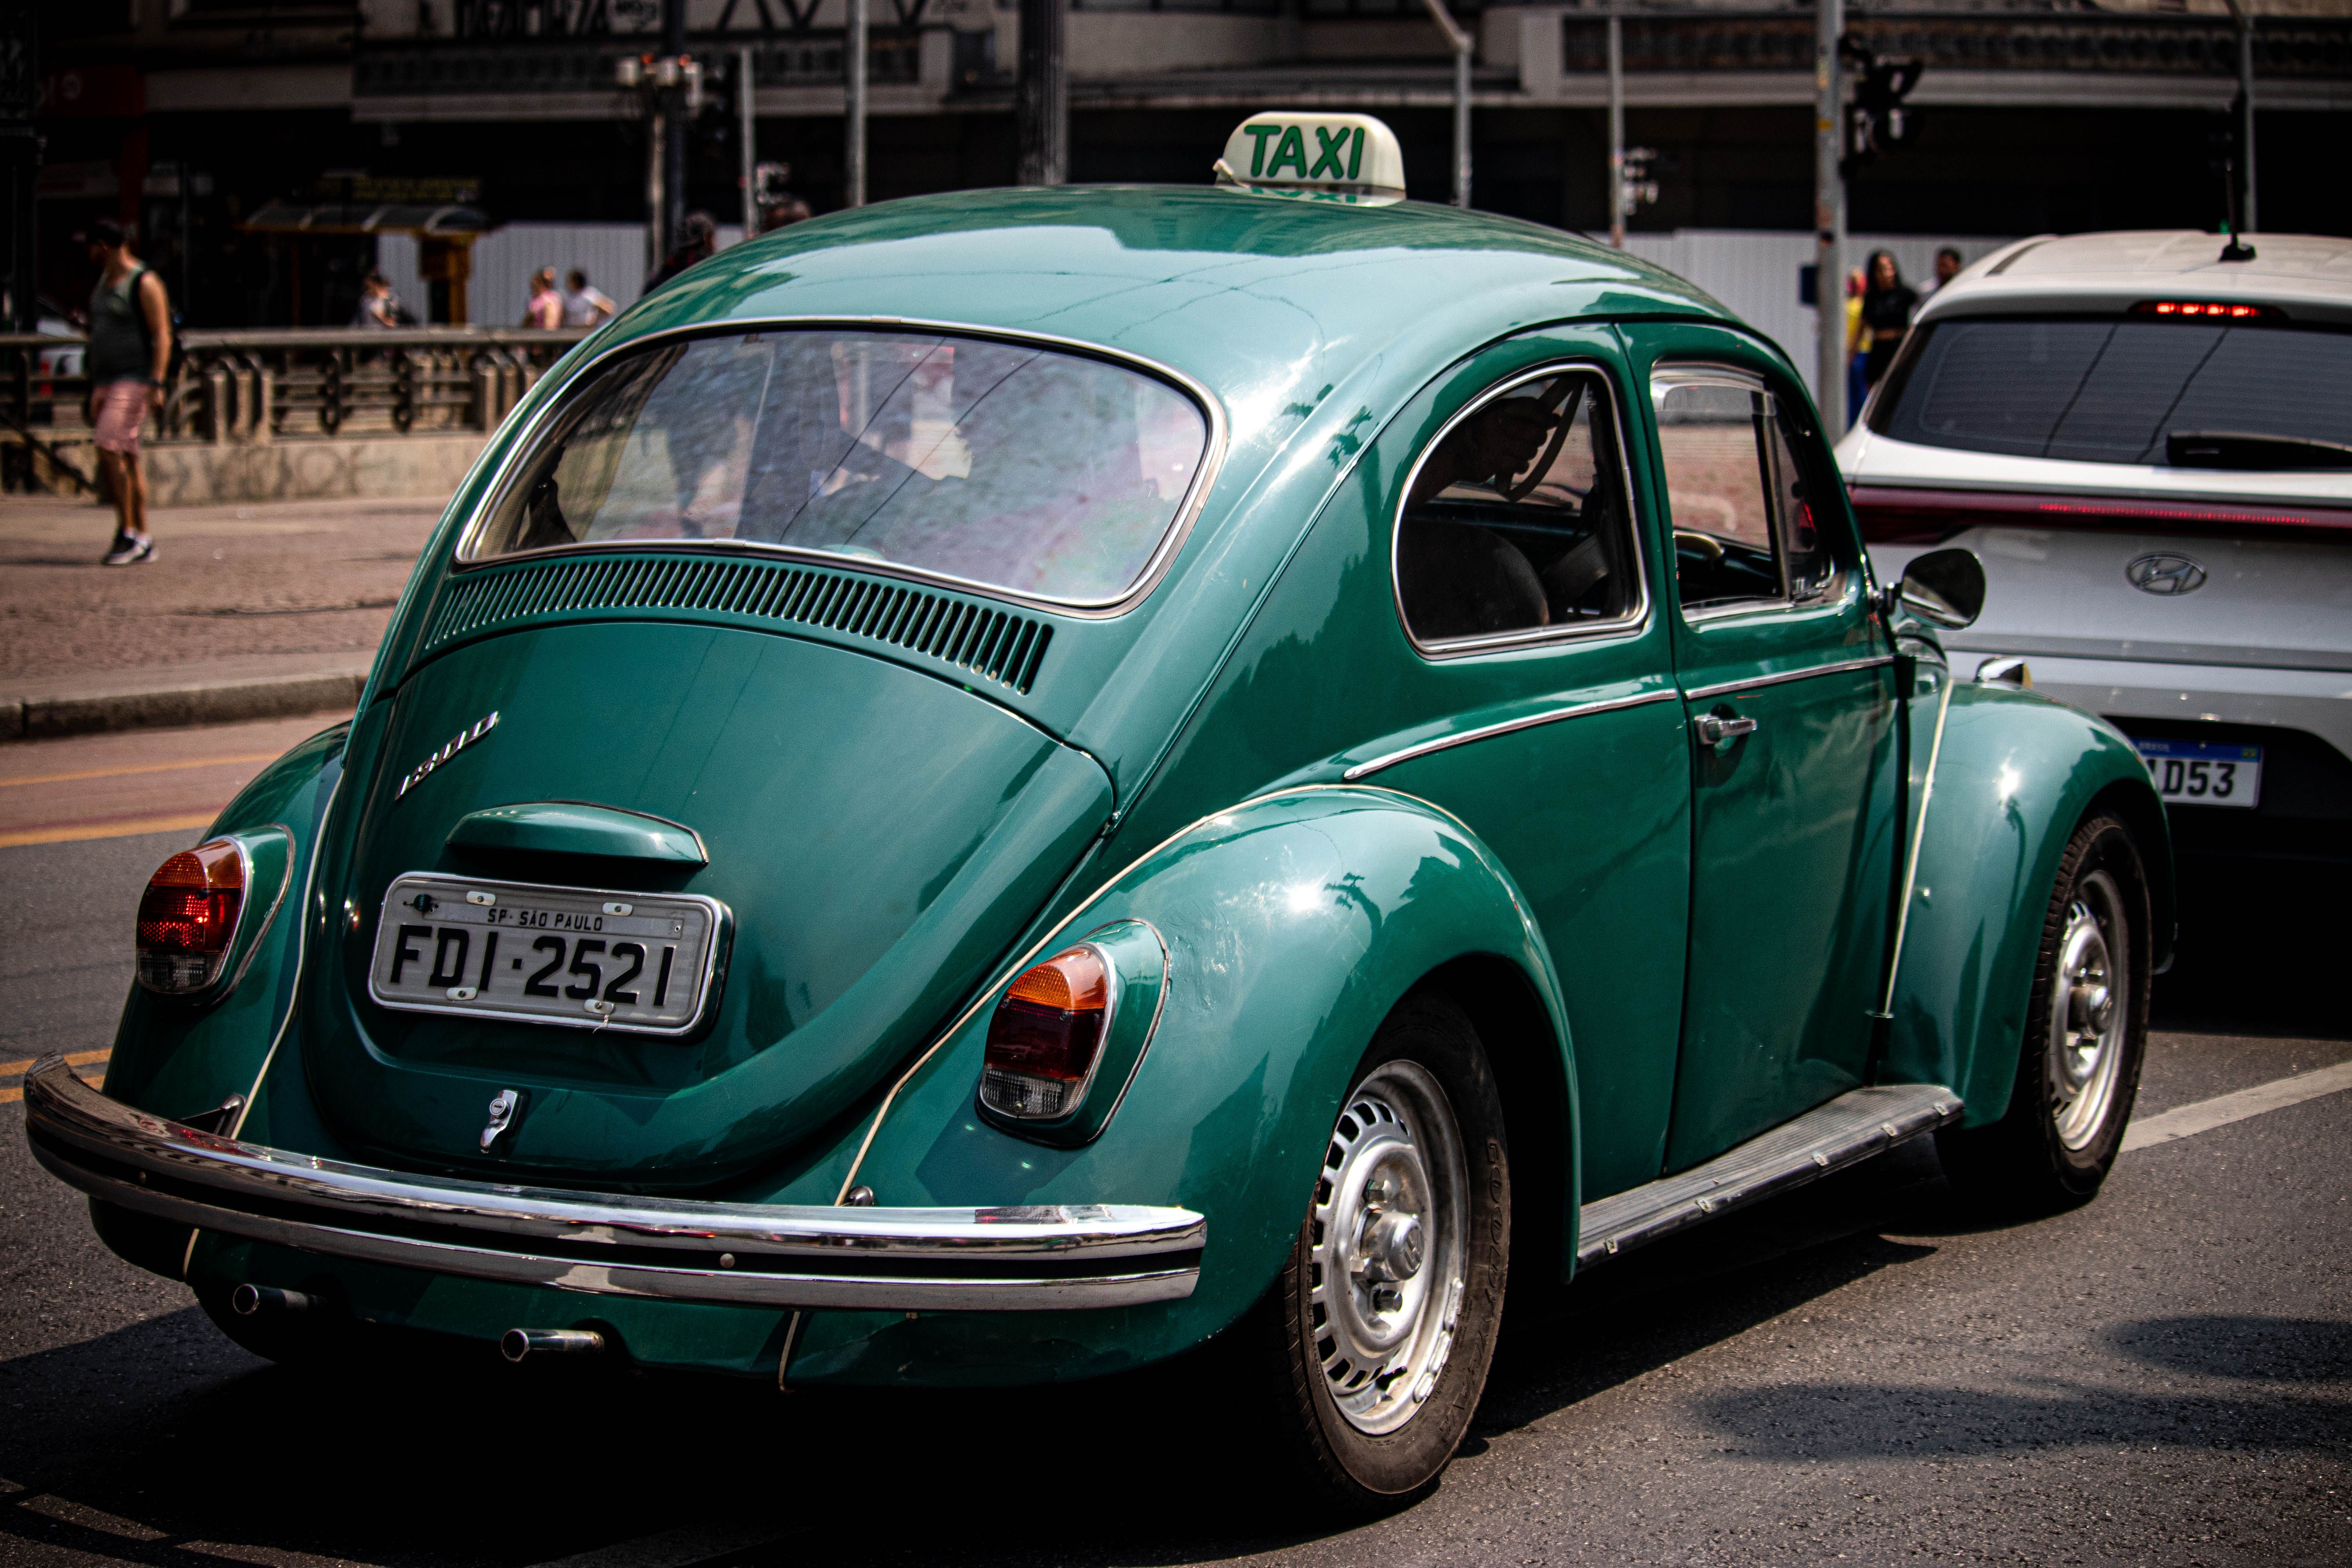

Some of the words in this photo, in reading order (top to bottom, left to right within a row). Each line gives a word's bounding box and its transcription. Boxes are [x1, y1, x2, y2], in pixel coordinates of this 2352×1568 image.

[1244, 125, 1365, 180] TAXI
[519, 910, 548, 927] SÃO
[554, 913, 603, 931] PAULO
